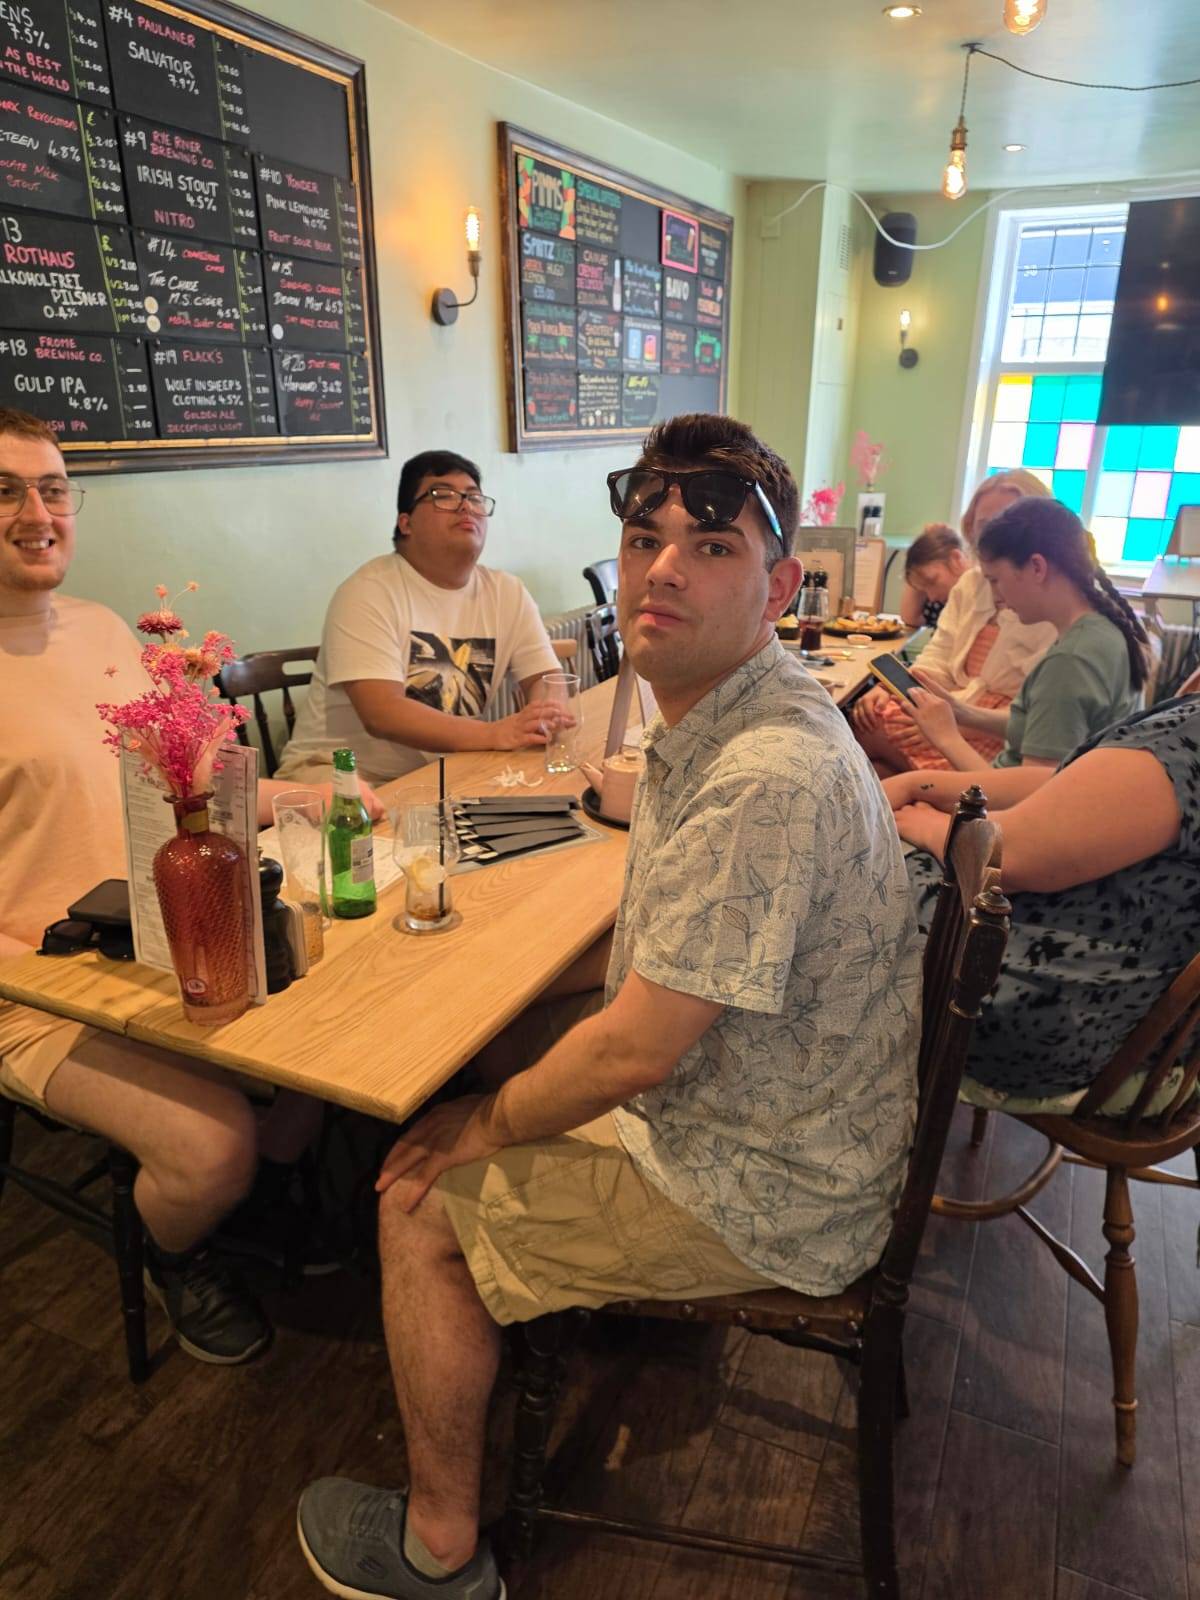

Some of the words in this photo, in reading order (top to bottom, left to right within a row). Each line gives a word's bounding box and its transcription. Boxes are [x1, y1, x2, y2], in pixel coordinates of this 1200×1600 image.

[108, 6, 133, 28] #4
[8, 22, 50, 50] 7.5%
[137, 16, 196, 48] PAULANER
[26, 52, 62, 72] BEST
[128, 41, 195, 79] SALVATOR
[32, 71, 70, 91] WORLD
[168, 74, 200, 95] 7.9%
[124, 131, 147, 150] #9
[137, 165, 174, 189] IRISH
[178, 175, 219, 197] STOUT
[266, 194, 287, 210] PINK
[154, 209, 196, 229] NITRO
[4, 243, 75, 268] ROTHAUS
[51, 289, 107, 306] PILSNER
[39, 336, 77, 349] FROME
[34, 347, 86, 361] BREWING
[154, 350, 177, 365] #19
[14, 374, 54, 393] GULP
[61, 377, 87, 394] IPA
[165, 378, 192, 392] WOLF
[68, 397, 108, 411] 4.8%
[172, 395, 216, 407] CLOTHING
[220, 410, 236, 420] ALE
